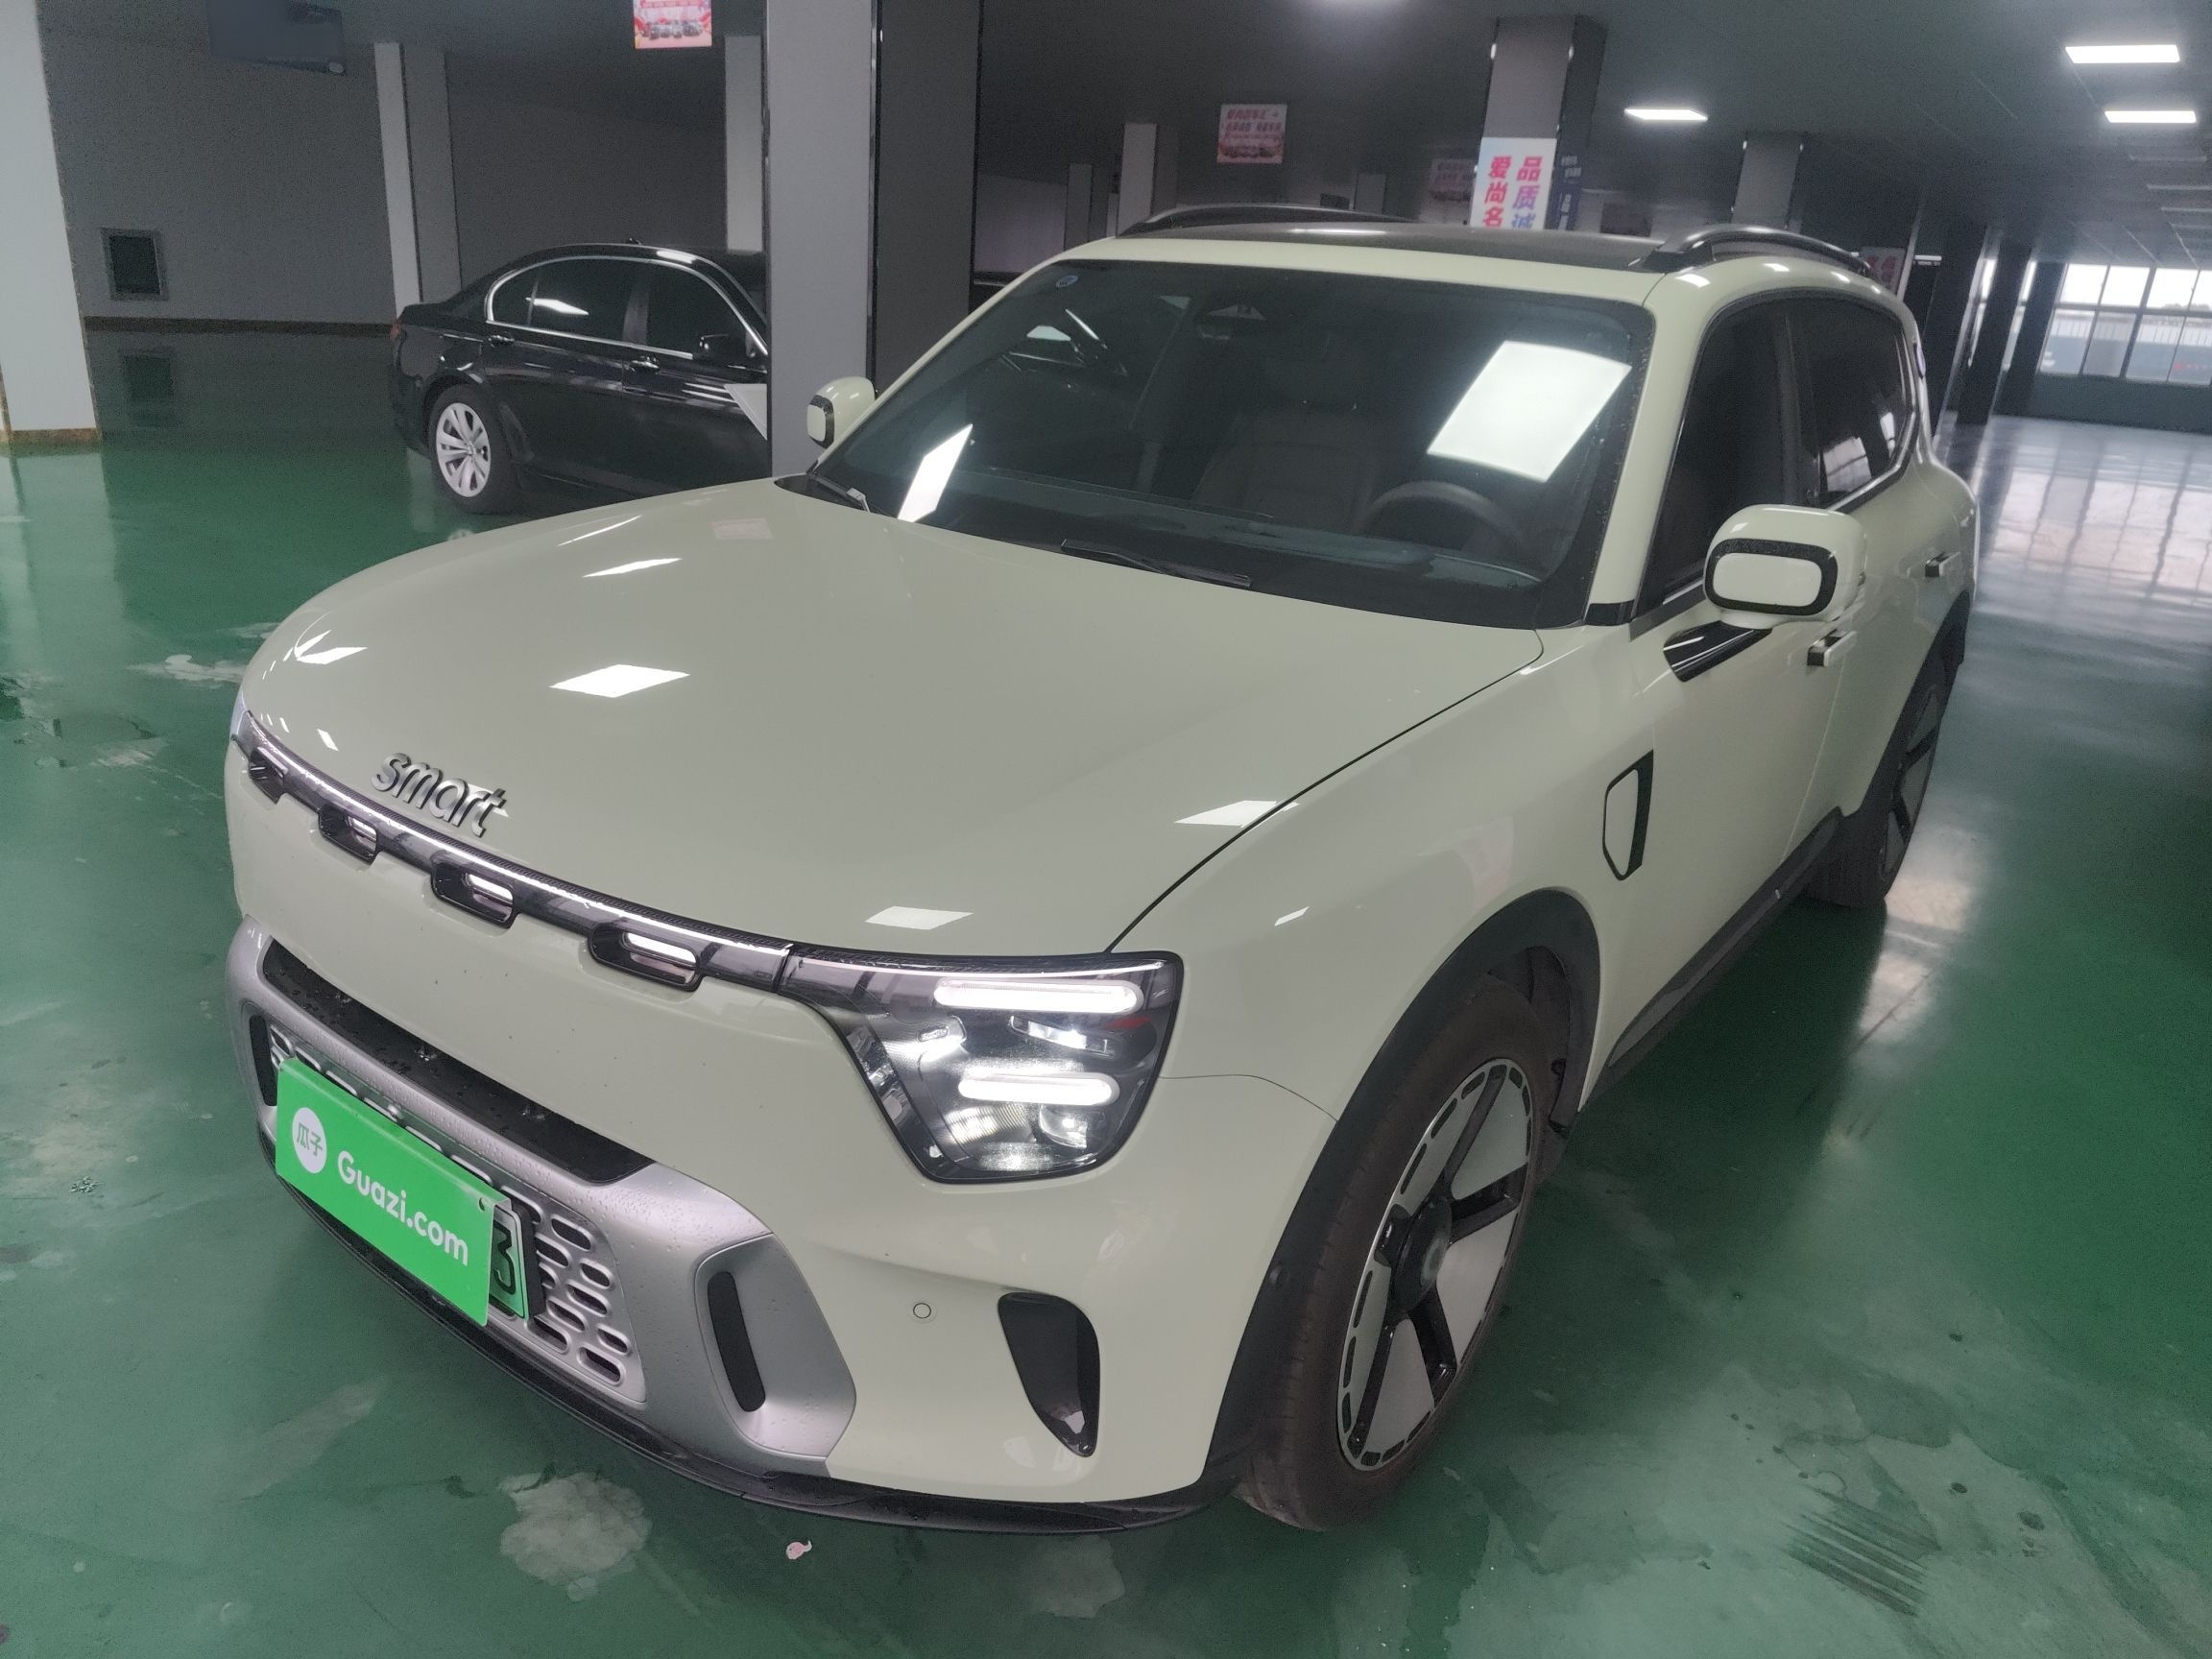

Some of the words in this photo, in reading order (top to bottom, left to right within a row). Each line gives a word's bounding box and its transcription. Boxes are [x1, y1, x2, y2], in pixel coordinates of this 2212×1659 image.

[372, 753, 507, 838] smart
[297, 1122, 324, 1157] 瓜子
[338, 1151, 469, 1267] Guazi.com
